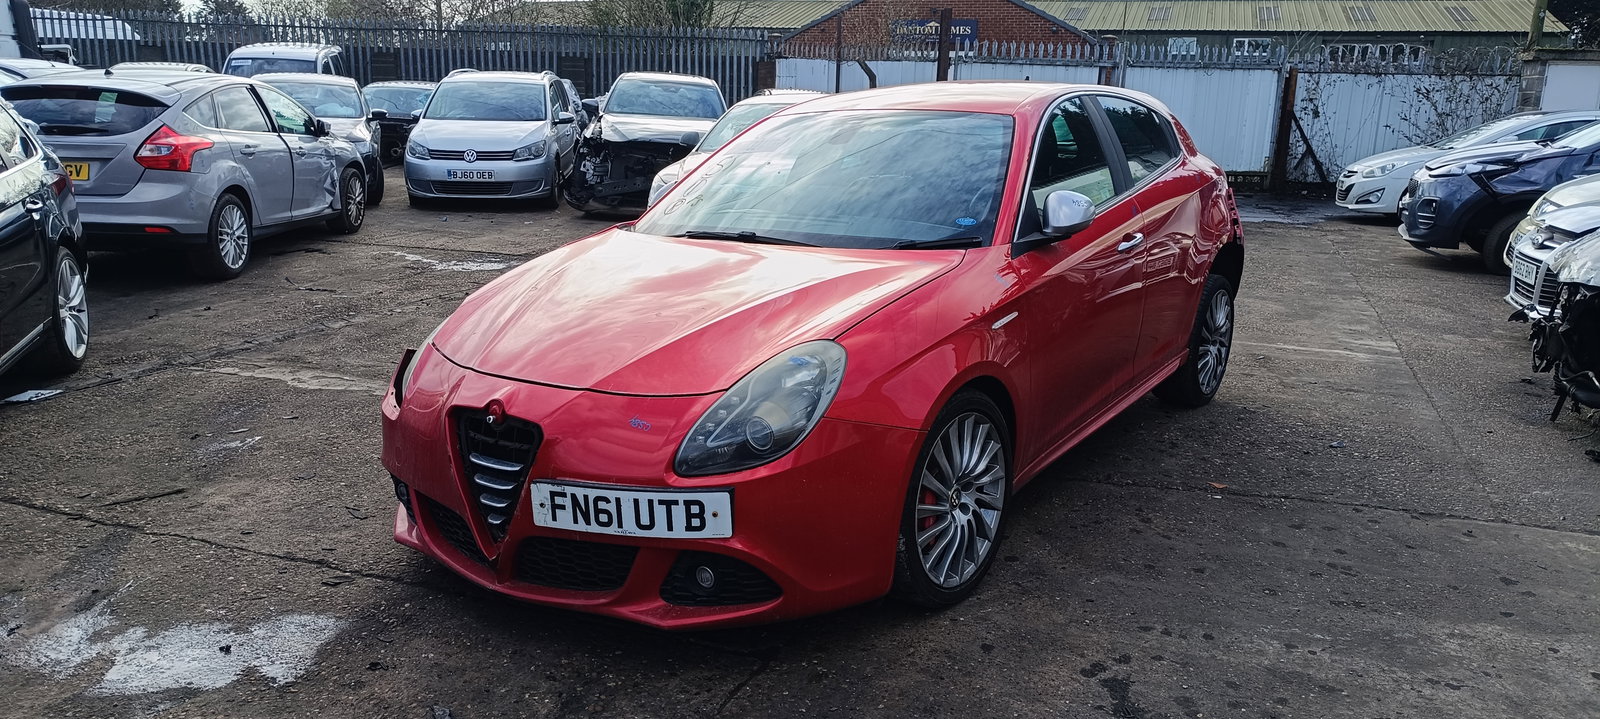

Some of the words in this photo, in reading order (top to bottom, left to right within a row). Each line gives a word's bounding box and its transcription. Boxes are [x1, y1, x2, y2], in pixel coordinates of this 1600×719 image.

[937, 26, 971, 35] MES
[452, 171, 474, 180] BJ60
[476, 171, 493, 180] OEB
[549, 490, 624, 529] FN61
[633, 497, 707, 532] UTB
